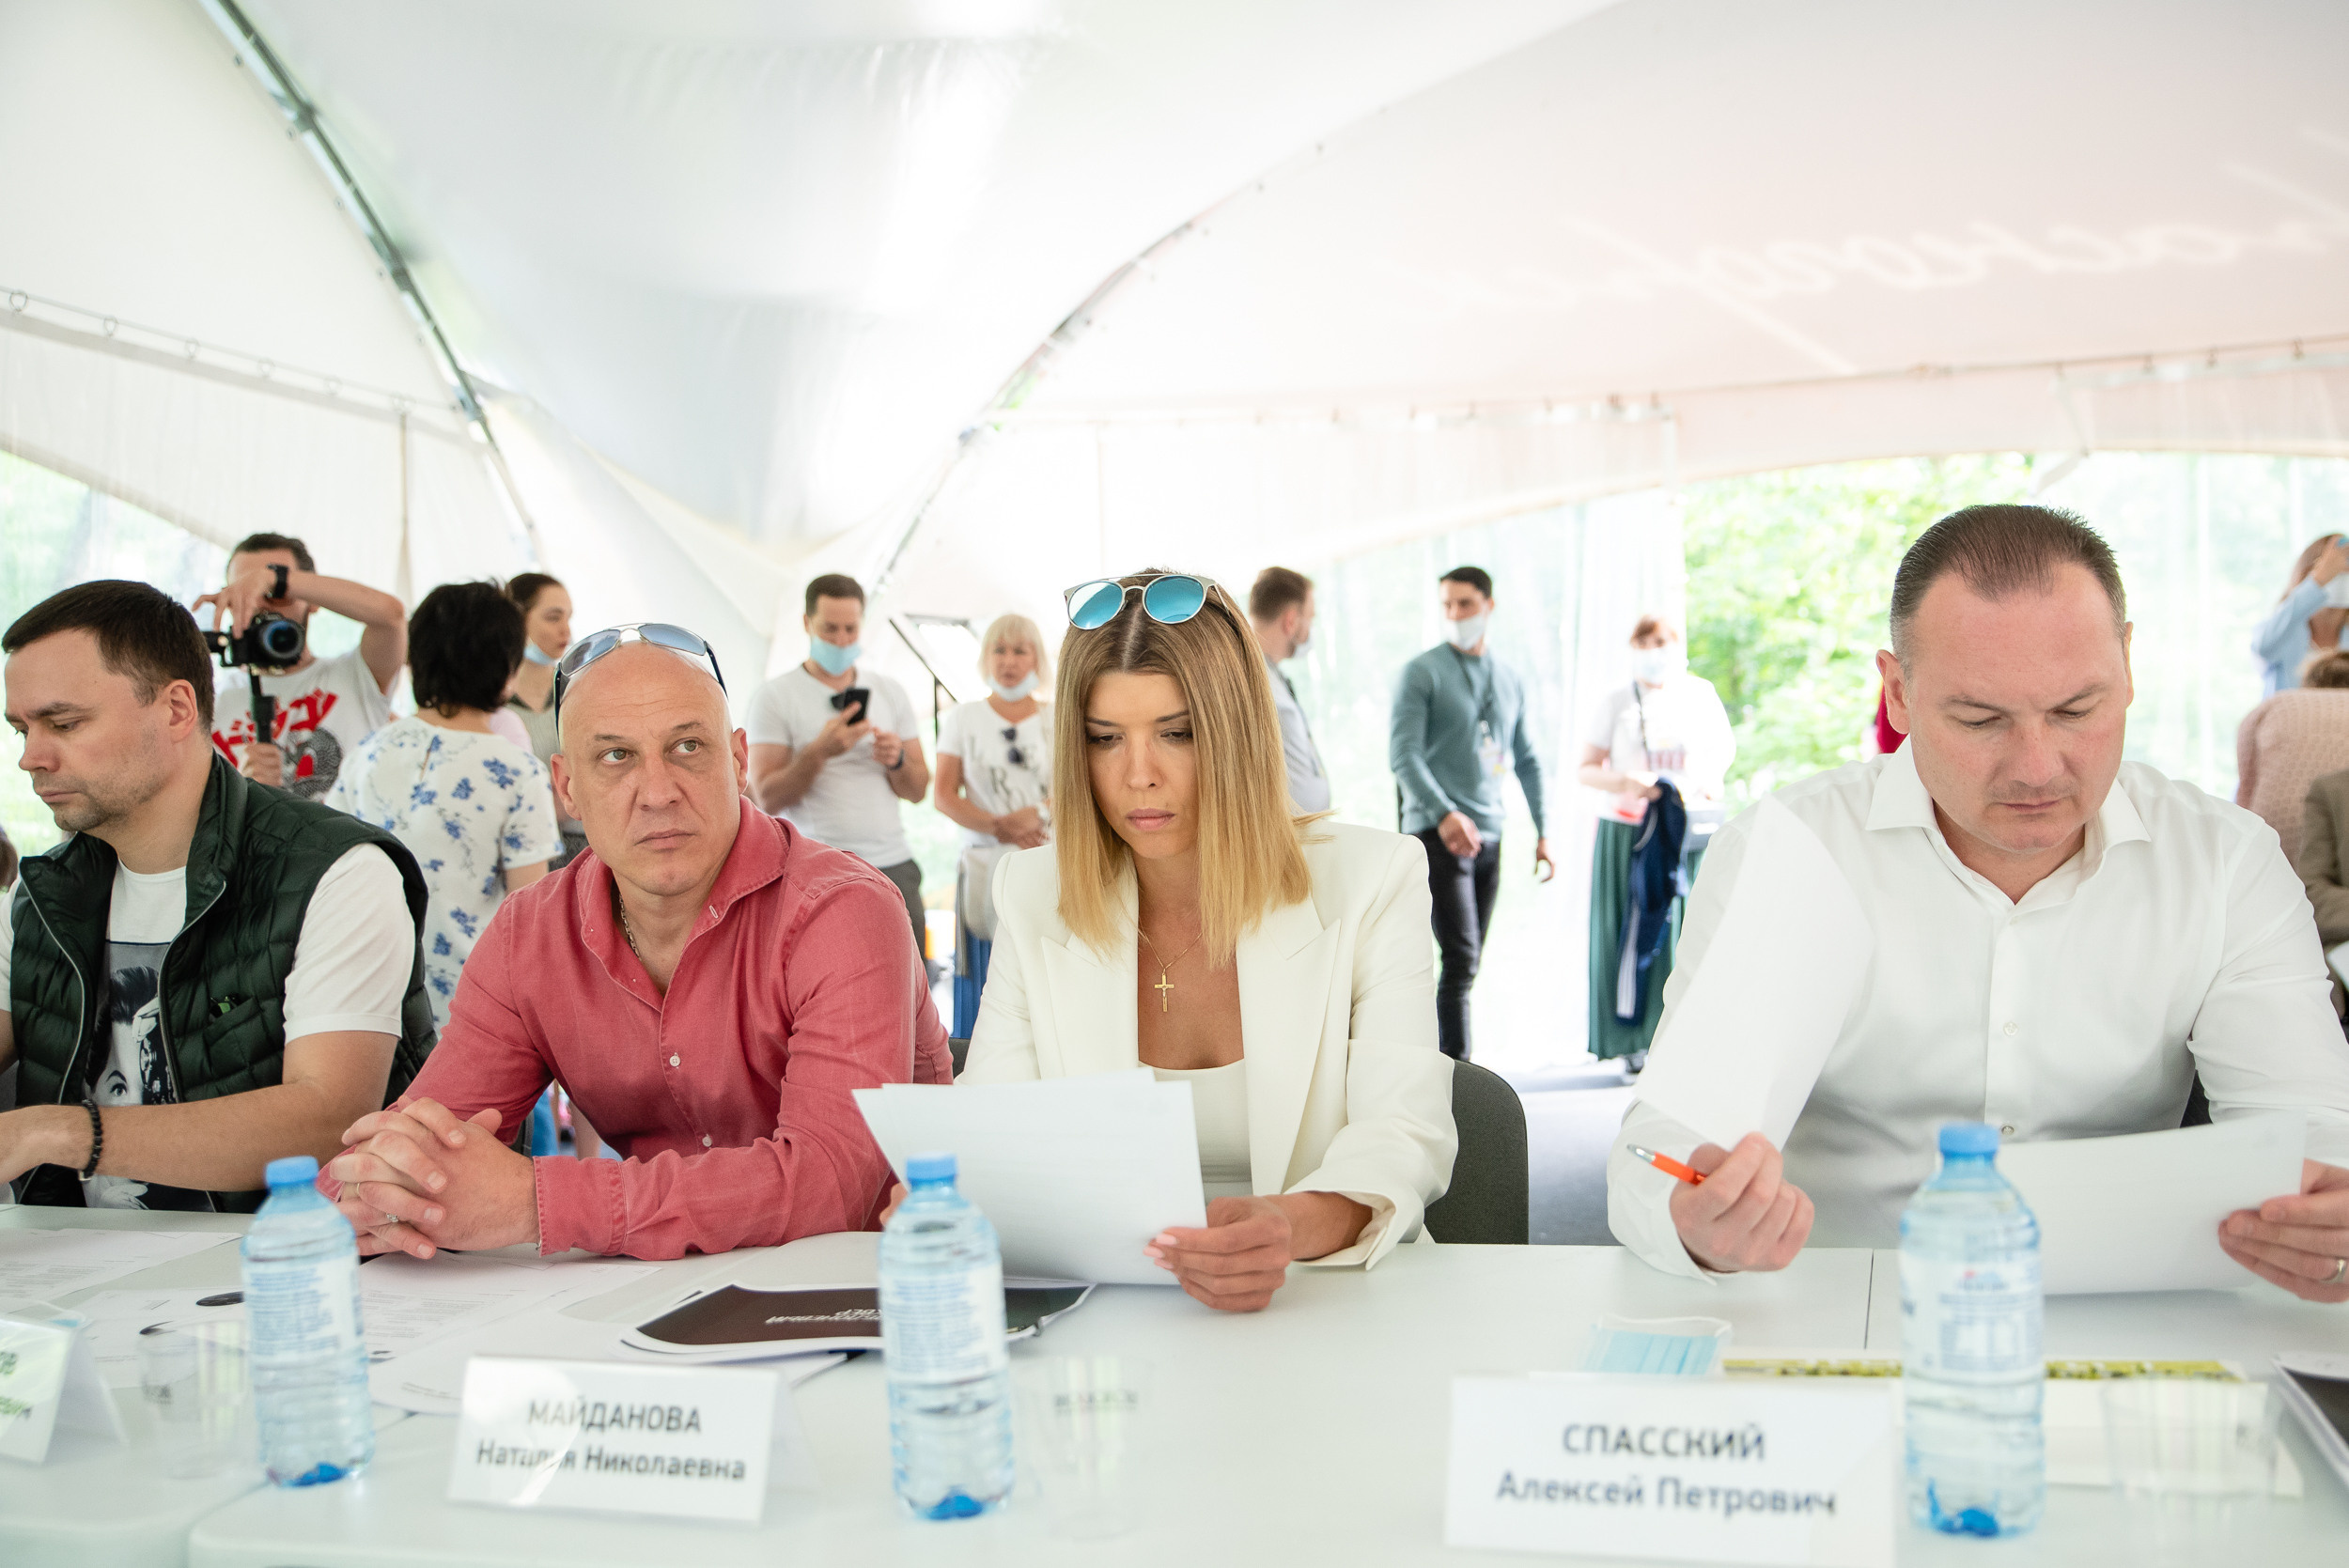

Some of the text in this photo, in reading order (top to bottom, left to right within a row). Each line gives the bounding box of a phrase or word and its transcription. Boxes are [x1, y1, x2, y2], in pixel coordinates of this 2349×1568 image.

[526, 1395, 702, 1435] МАЙДАНОВА
[1562, 1421, 1766, 1461] СПАССКИЙ
[583, 1443, 746, 1482] Николаевна
[1496, 1469, 1838, 1518] Алексей Петрович
